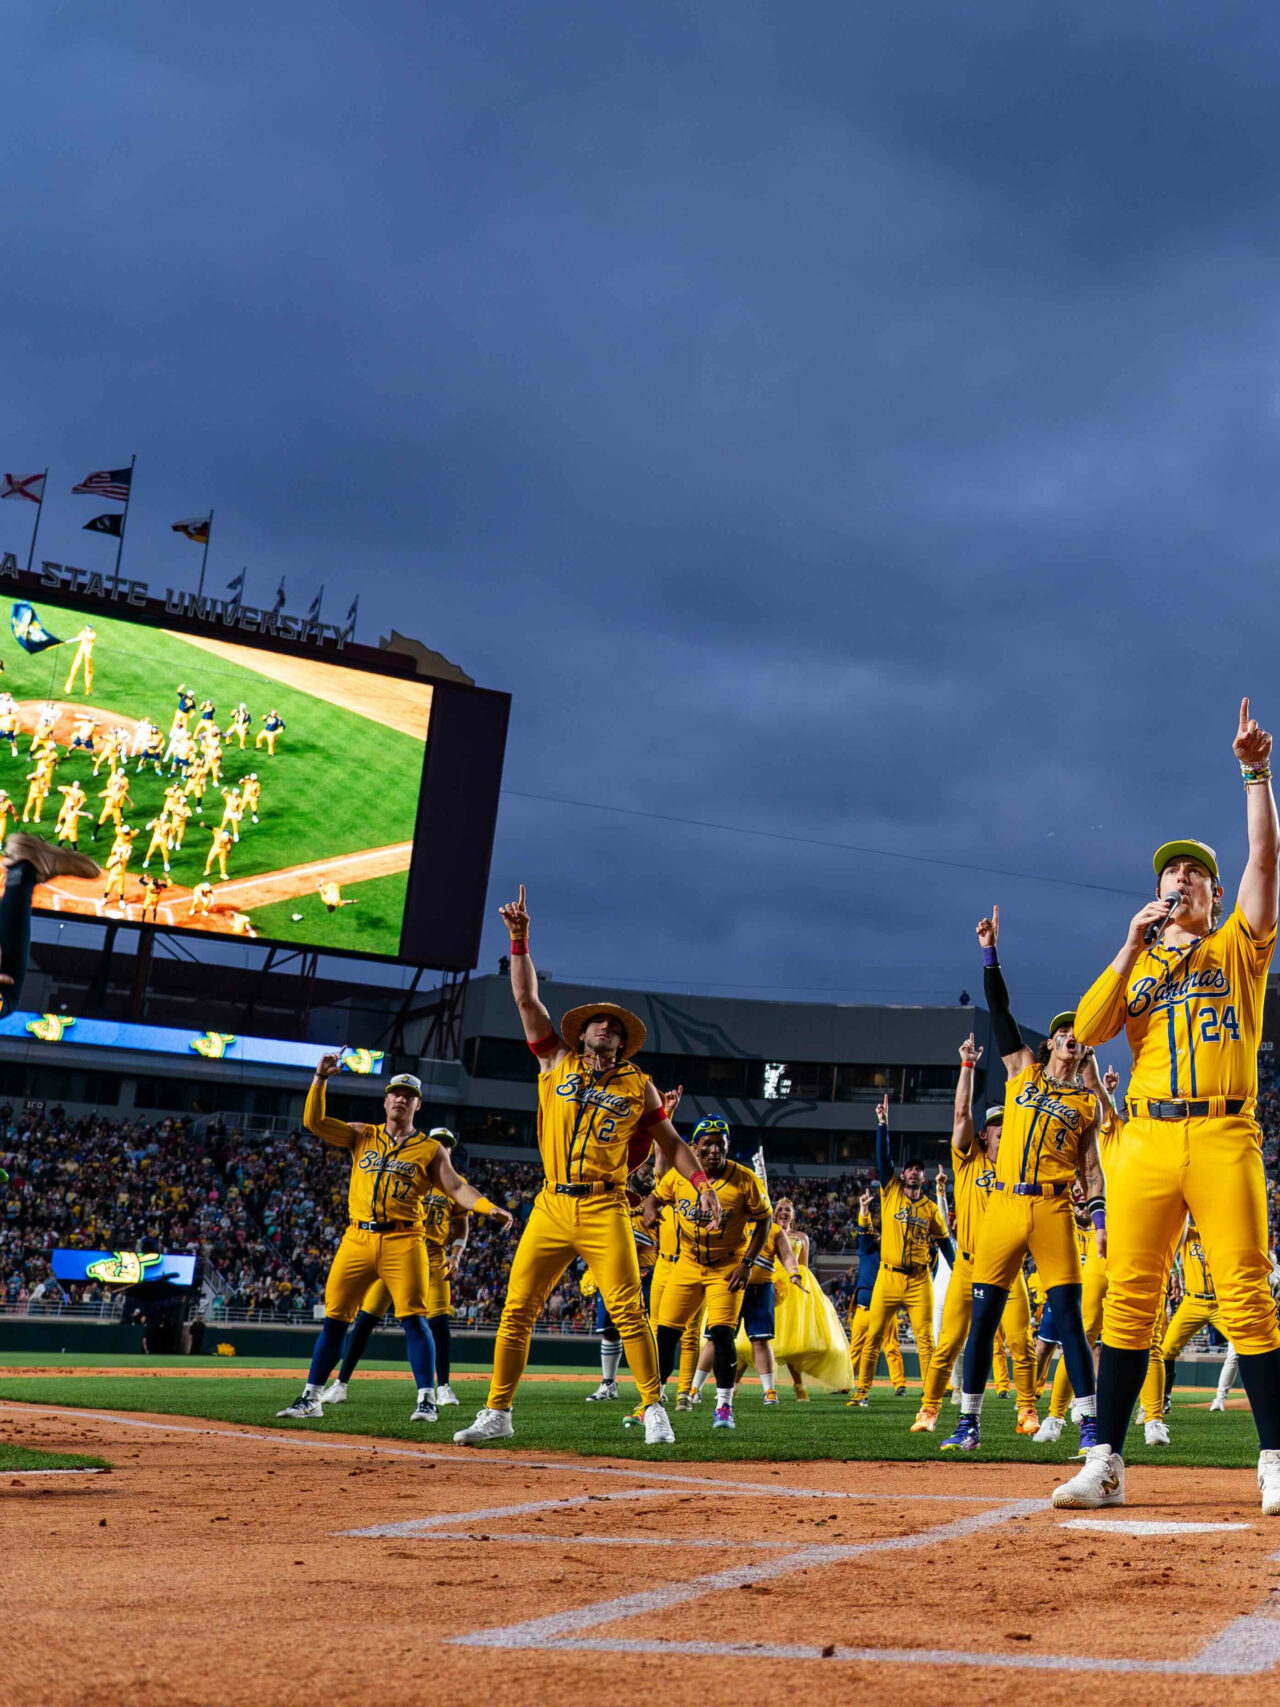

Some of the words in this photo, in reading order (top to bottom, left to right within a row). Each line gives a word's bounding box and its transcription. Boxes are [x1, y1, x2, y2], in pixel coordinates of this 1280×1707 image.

[40, 561, 148, 607] STATE
[165, 588, 351, 650] UNIVERSITY
[1127, 967, 1231, 1019] Bananas
[1198, 1004, 1240, 1042] 24
[556, 1073, 631, 1117] Bananas
[1015, 1082, 1080, 1131] Bananas
[597, 1118, 616, 1142] 2
[1055, 1128, 1067, 1151] 4
[359, 1150, 417, 1179] Bananas
[391, 1179, 413, 1200] 17
[678, 1198, 736, 1222] Banaas
